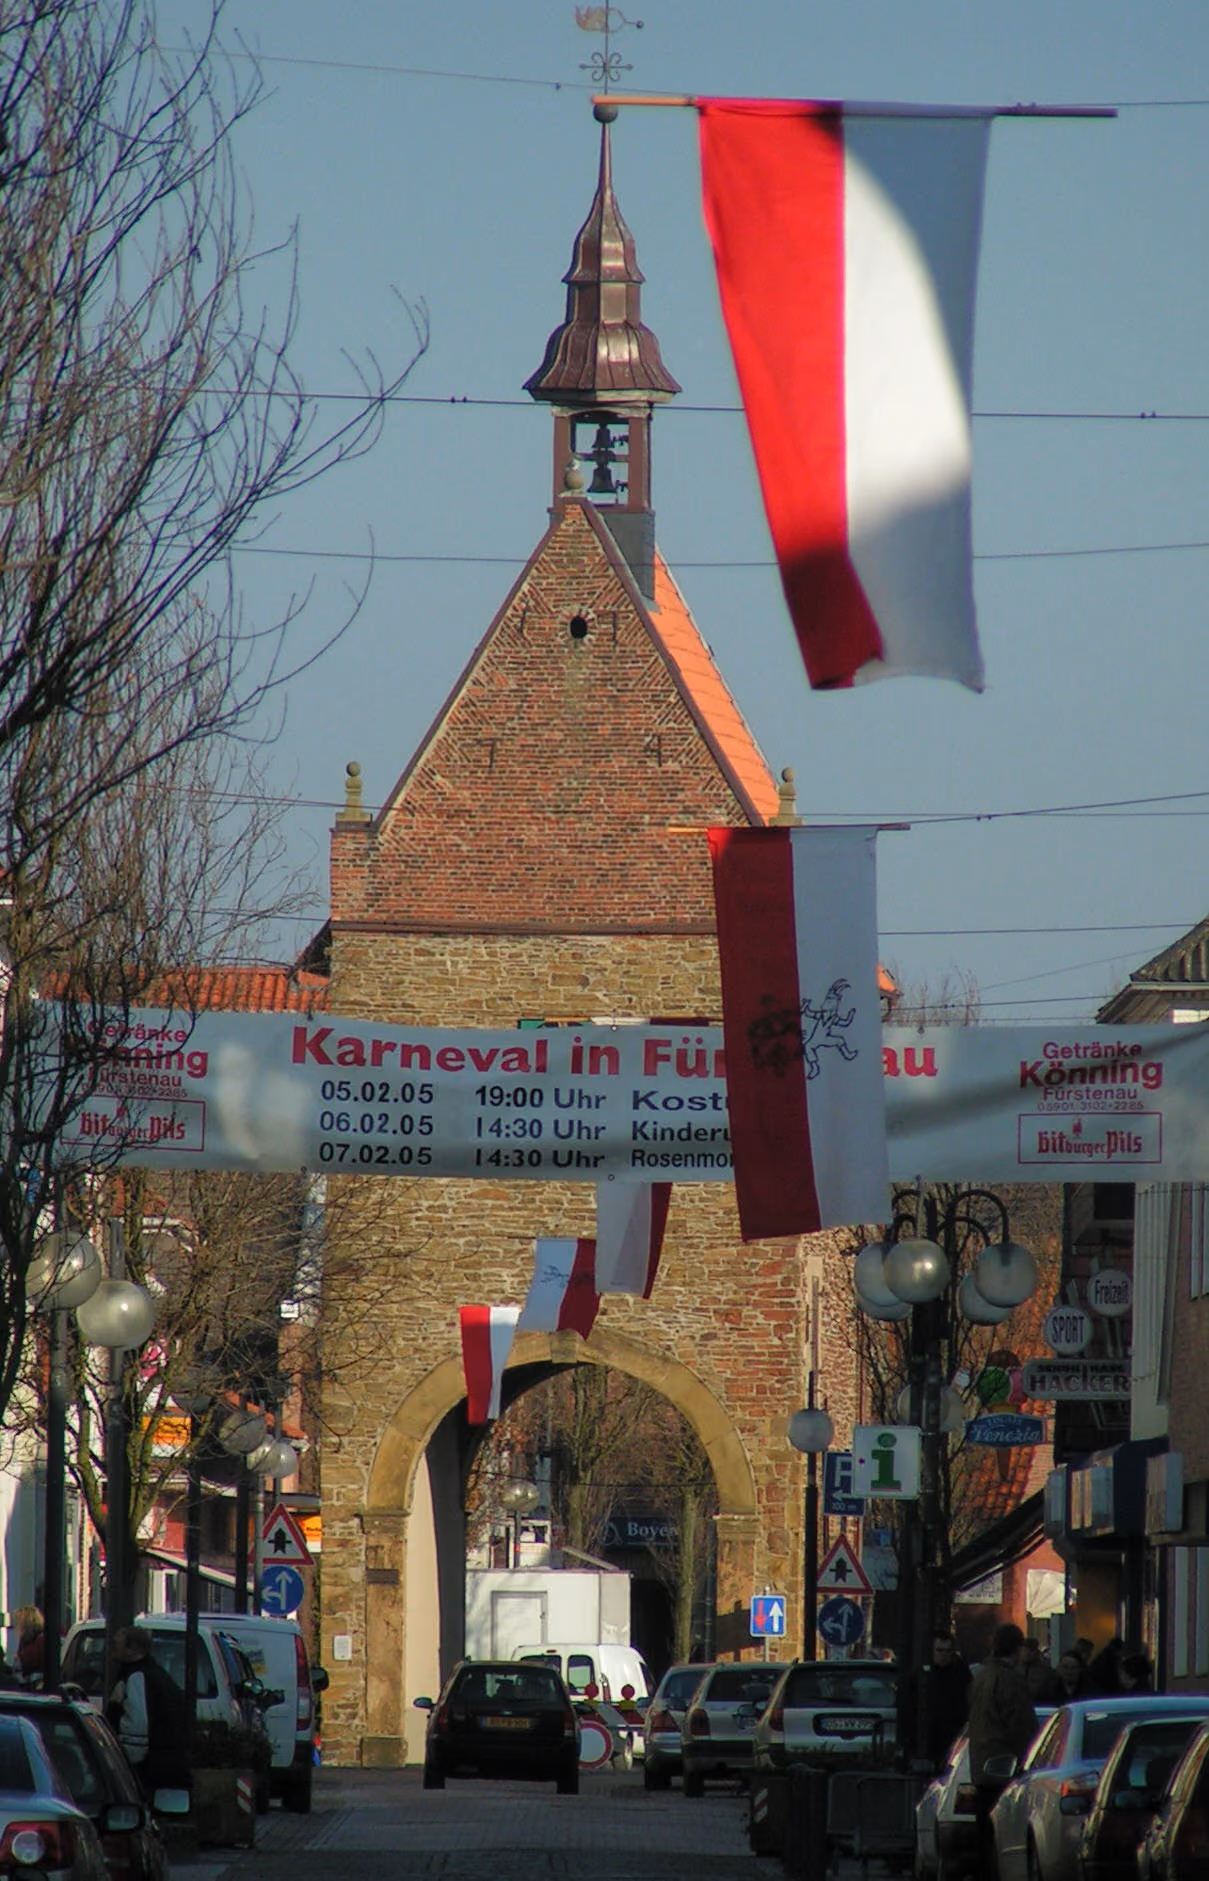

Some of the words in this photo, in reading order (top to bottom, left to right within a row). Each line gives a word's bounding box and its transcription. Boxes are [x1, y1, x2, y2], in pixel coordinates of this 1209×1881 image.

[291, 1026, 548, 1074] Karneval
[570, 1036, 620, 1076] in
[1042, 1041, 1143, 1060] Getränke
[1019, 1059, 1164, 1091] Könning
[320, 1080, 434, 1104] 05.02.05
[474, 1085, 544, 1108] 19:00
[553, 1087, 607, 1110] Uhr
[631, 1089, 728, 1112] Kost
[1042, 1086, 1138, 1101] Fürstenau
[319, 1110, 434, 1136] 06.02.05
[475, 1116, 543, 1139] 14:30
[553, 1119, 607, 1141] Uhr
[318, 1142, 433, 1166] 07.02.05
[474, 1148, 542, 1168] 14:30
[551, 1149, 606, 1169] Uhr
[1105, 1130, 1143, 1160] Pils
[1052, 1315, 1085, 1344] SPORT
[1029, 1372, 1130, 1393] HACKER
